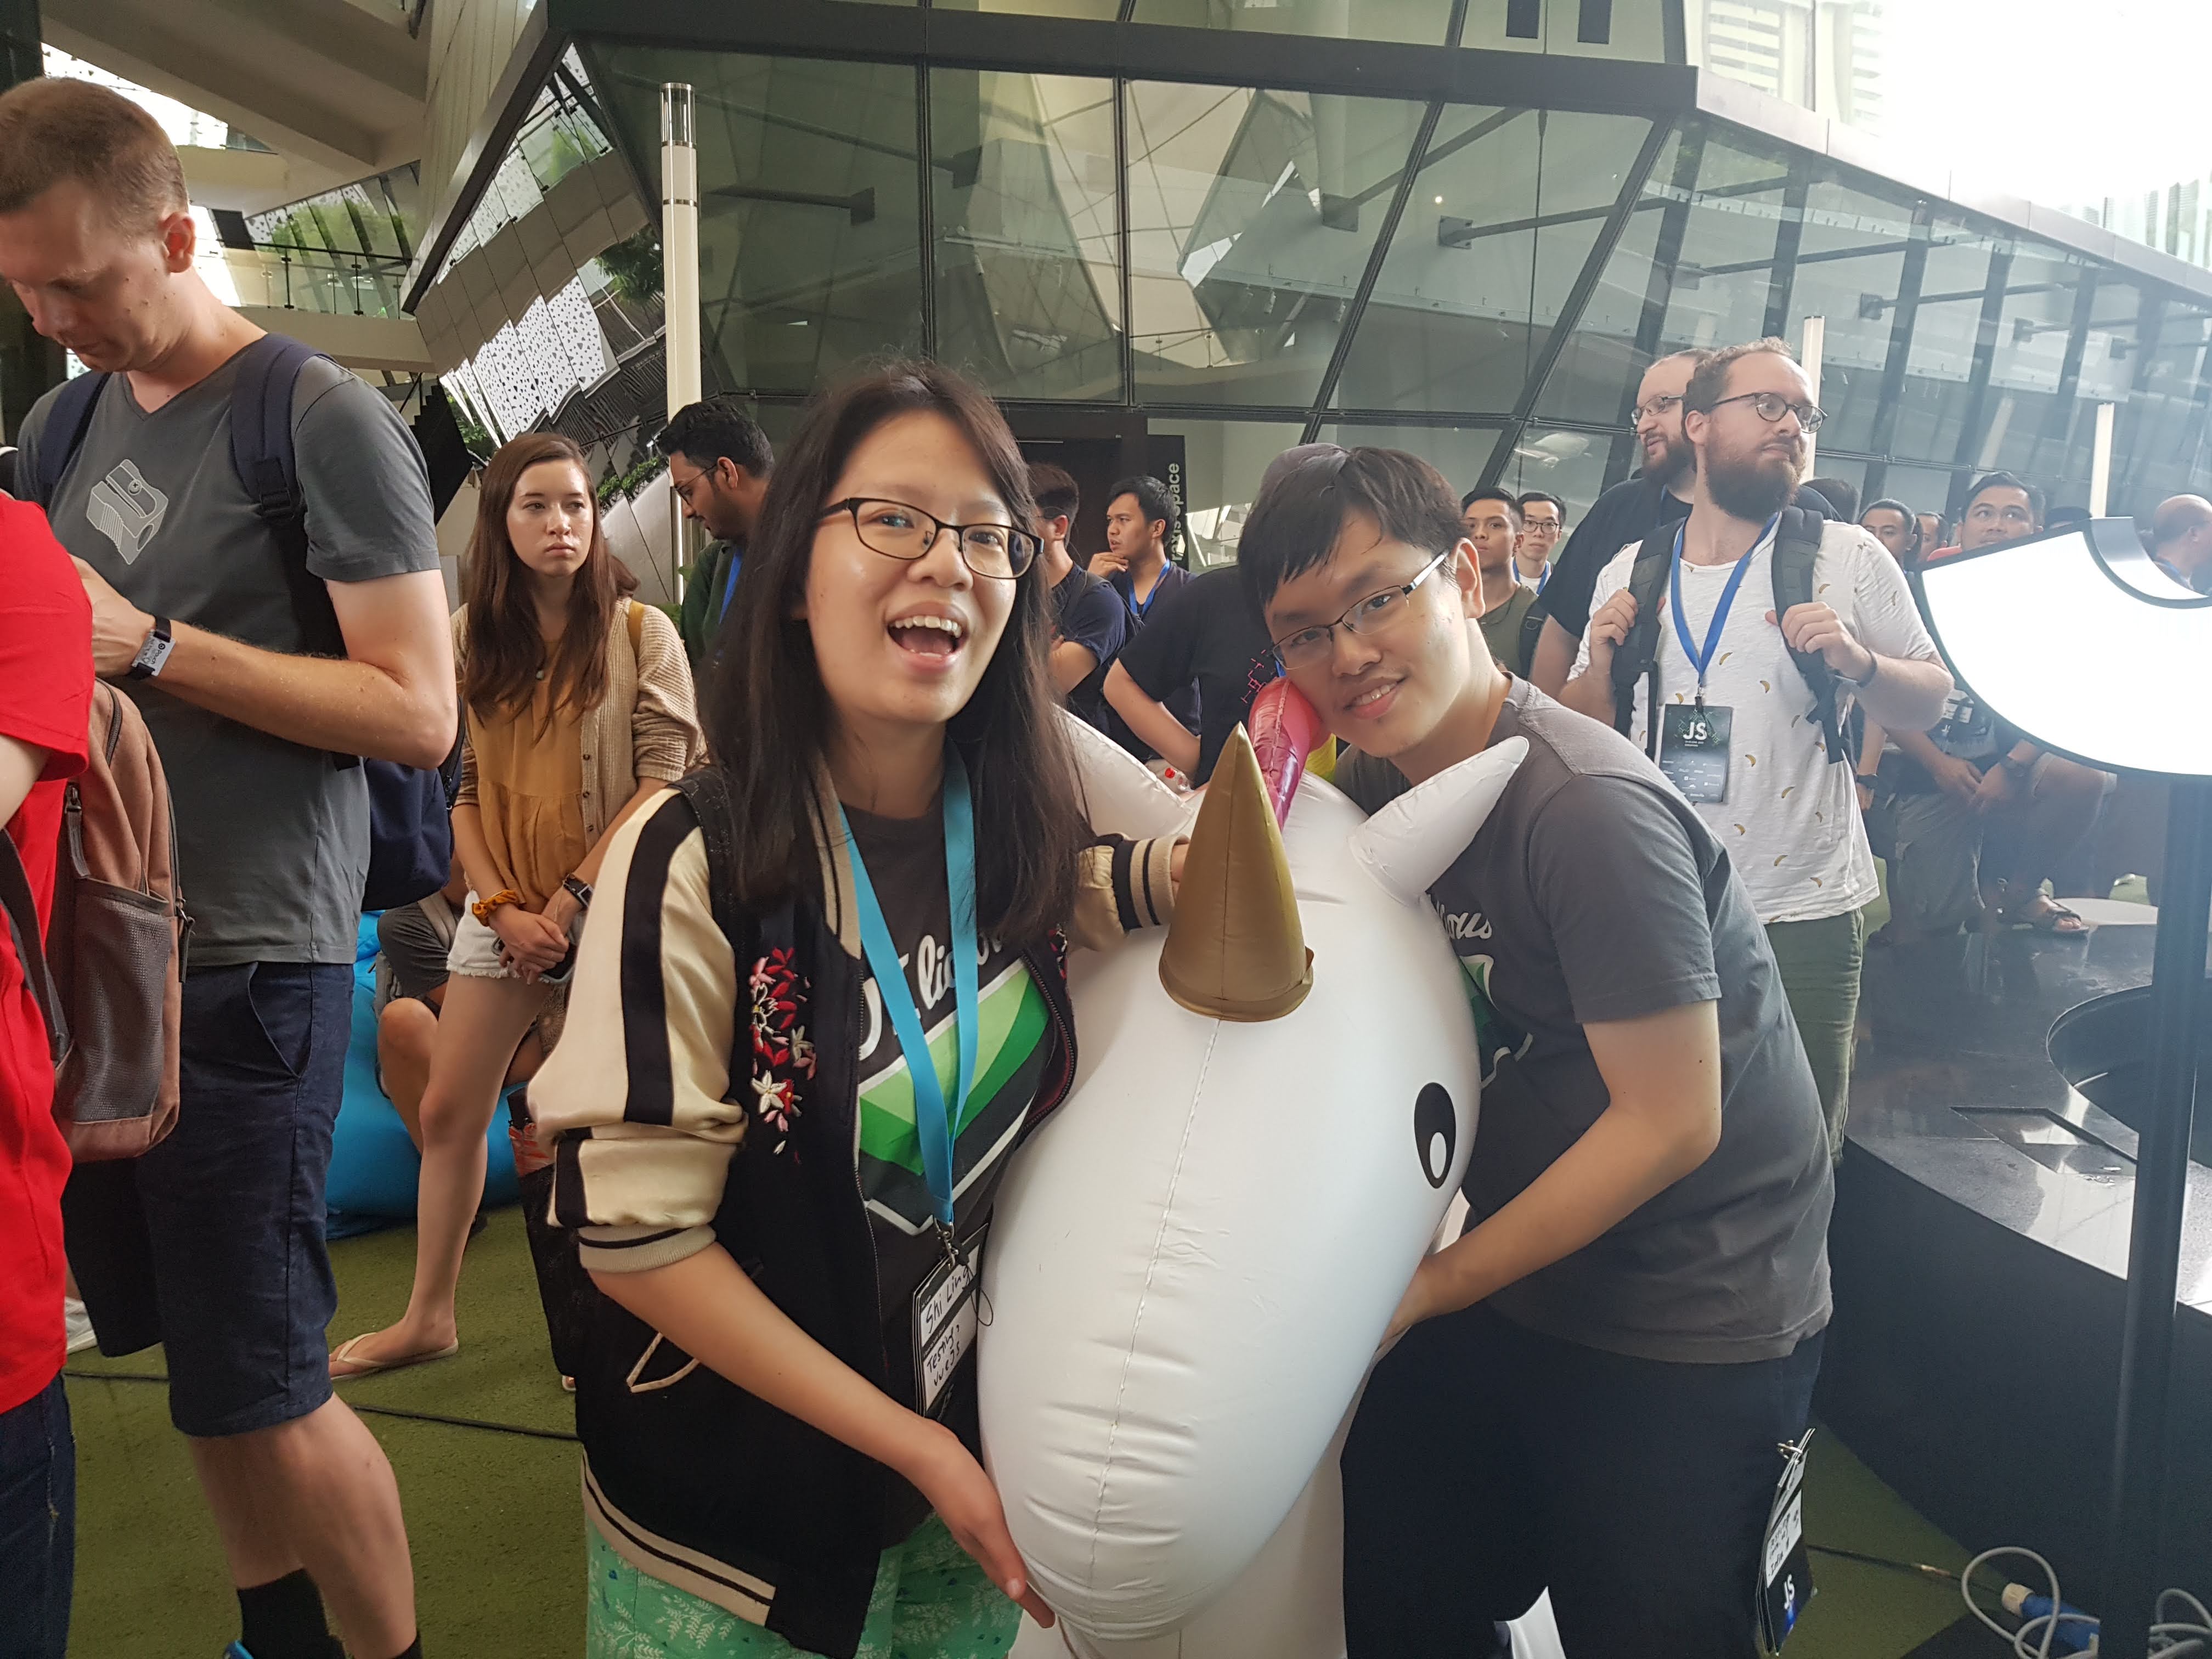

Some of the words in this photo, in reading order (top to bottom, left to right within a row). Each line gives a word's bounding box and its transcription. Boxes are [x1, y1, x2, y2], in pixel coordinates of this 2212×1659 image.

[1683, 722, 1707, 740] JS
[926, 1293, 943, 1334] Shi
[946, 1265, 970, 1302] Ling
[1784, 1573, 1795, 1610] JS
